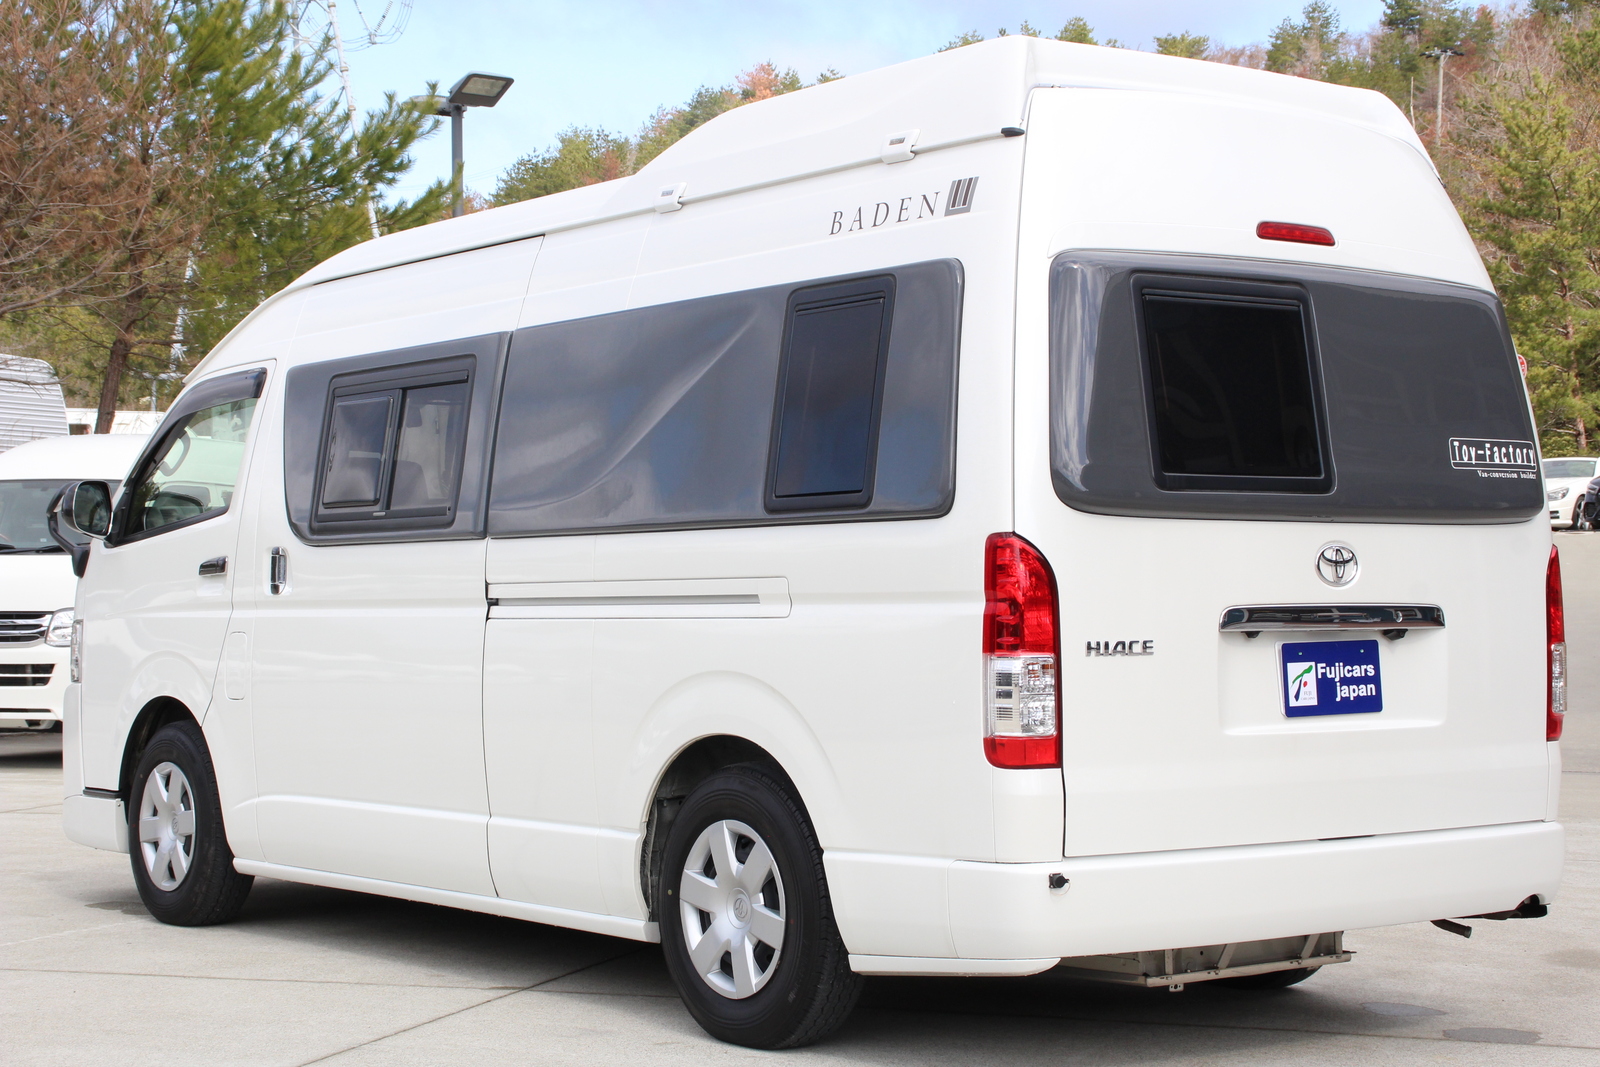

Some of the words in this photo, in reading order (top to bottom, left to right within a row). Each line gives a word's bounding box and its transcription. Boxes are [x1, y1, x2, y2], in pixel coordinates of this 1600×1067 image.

[829, 191, 941, 235] BADEN
[1453, 441, 1535, 466] Toy-Factory
[1477, 470, 1518, 479] Van-conversion
[1085, 640, 1154, 657] HIACE
[1317, 662, 1375, 682] Fujicars
[1335, 682, 1376, 702] japan
